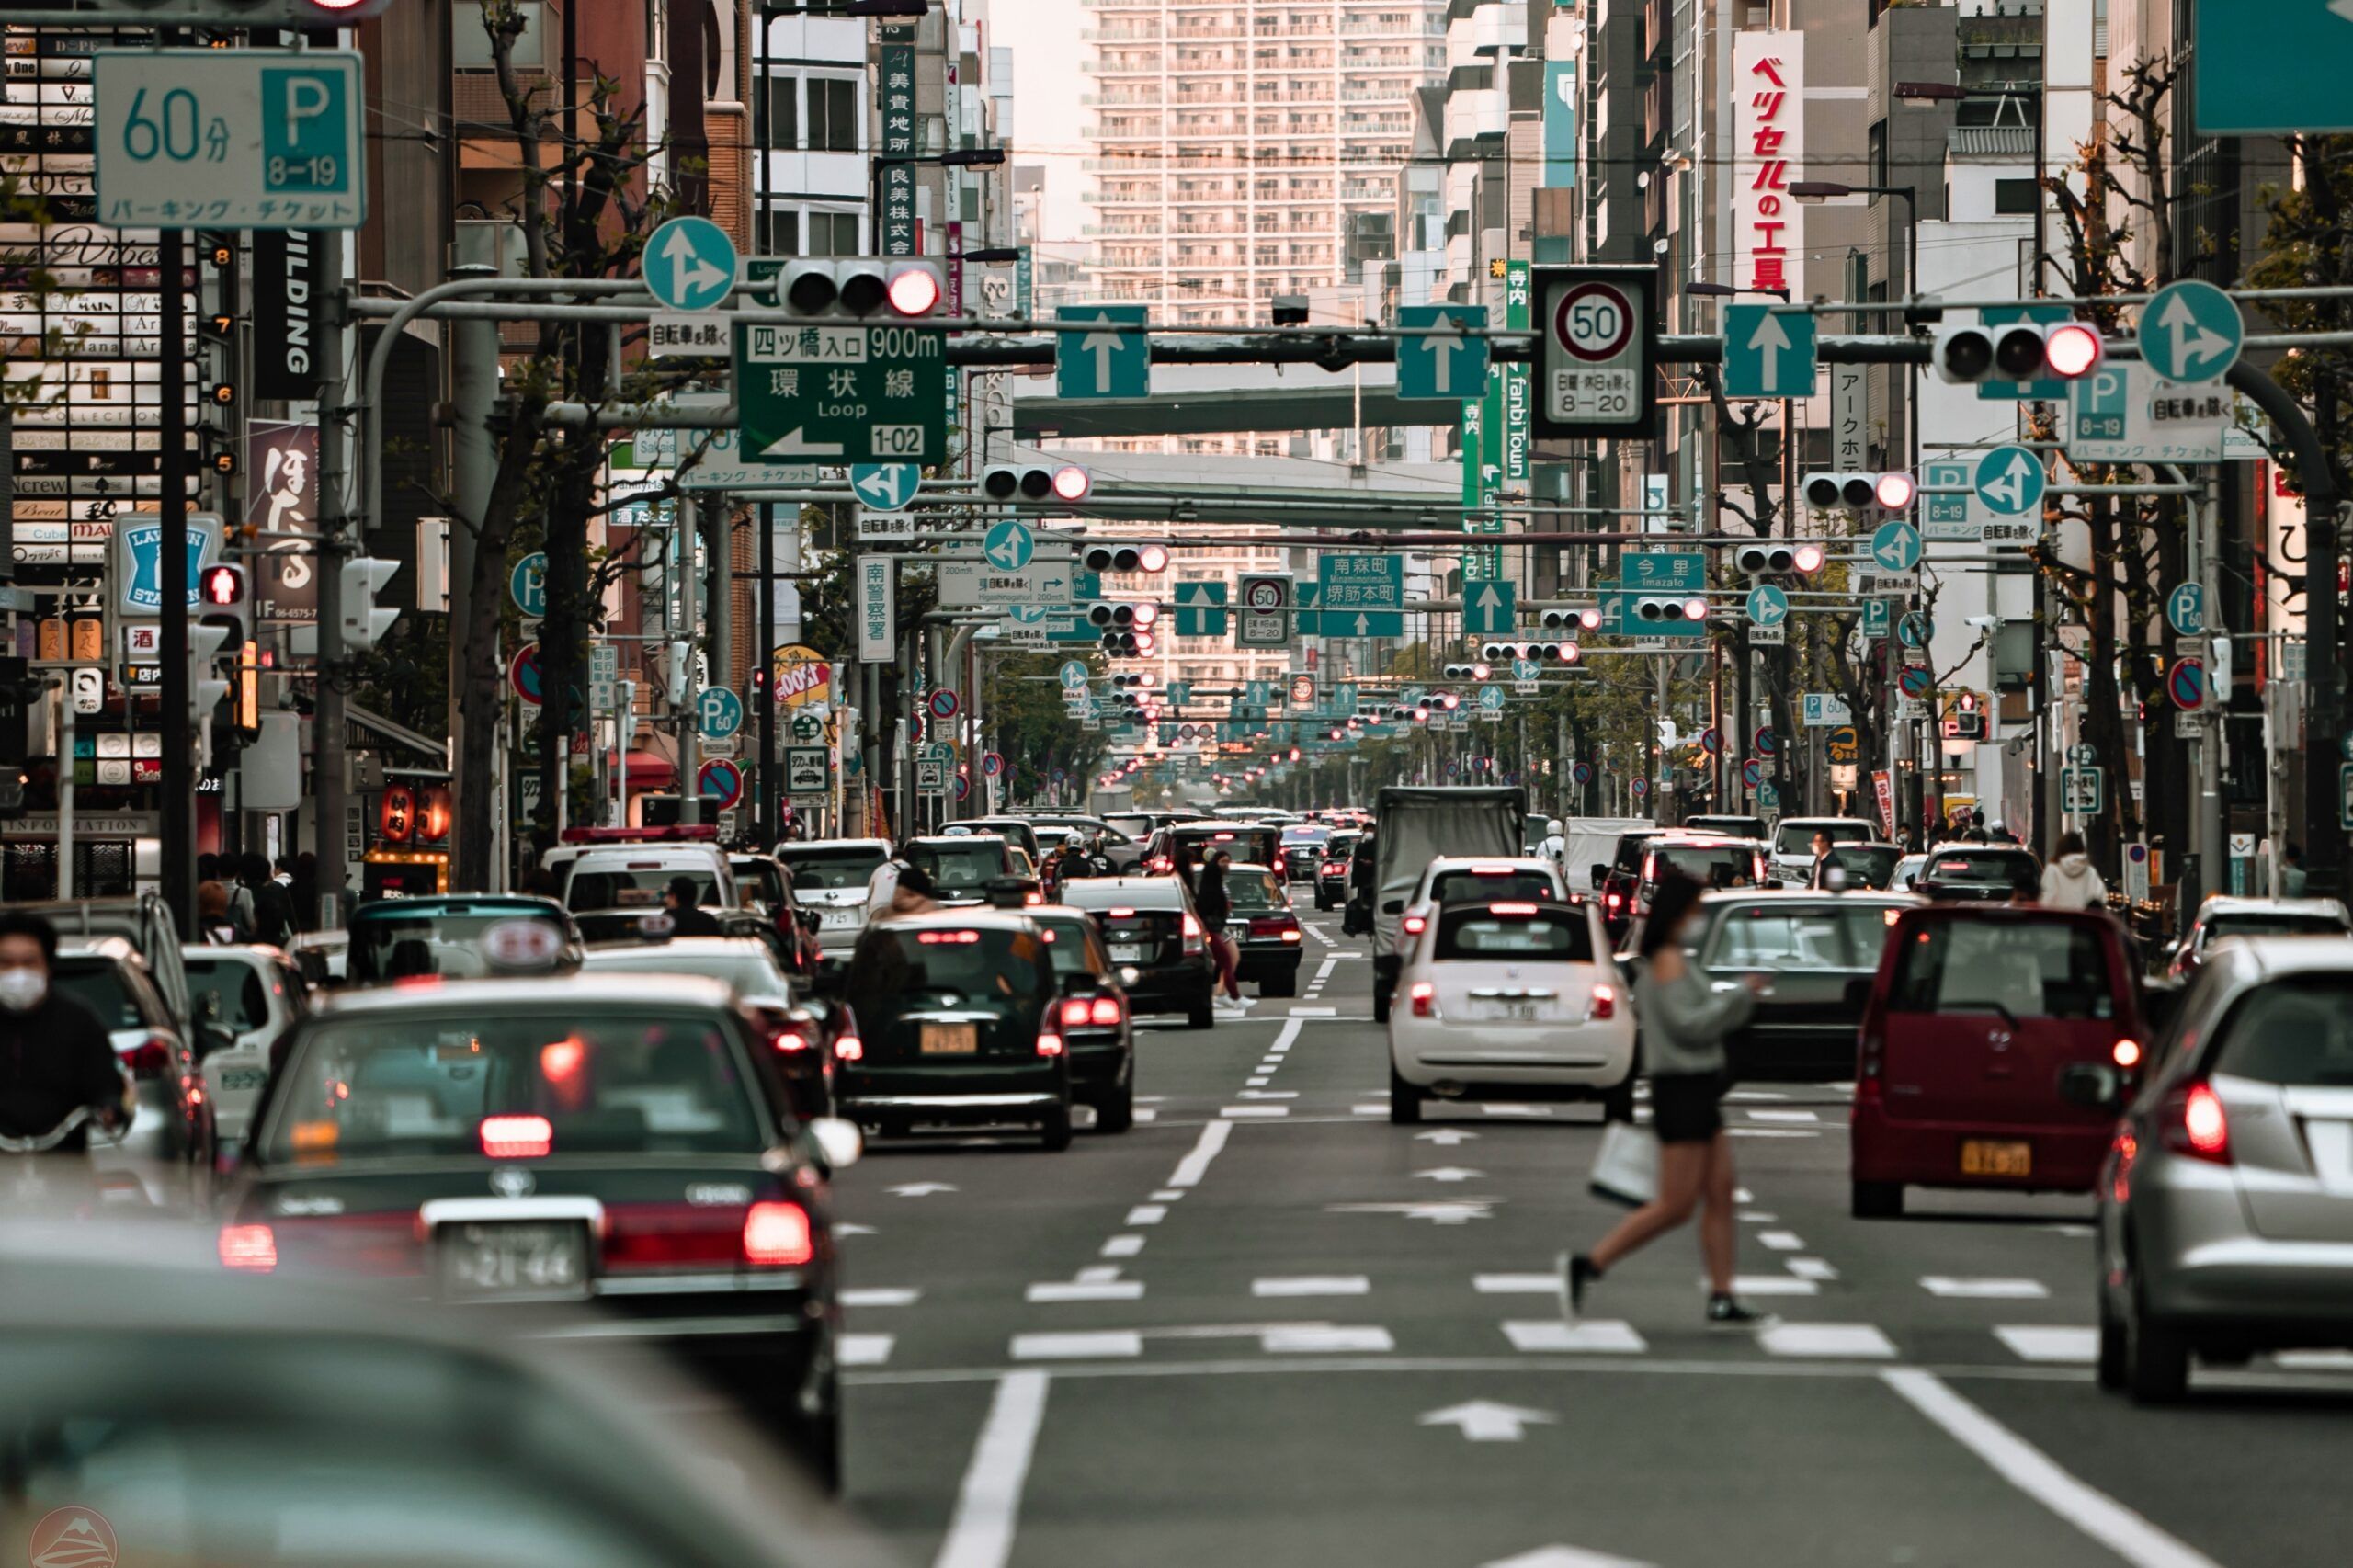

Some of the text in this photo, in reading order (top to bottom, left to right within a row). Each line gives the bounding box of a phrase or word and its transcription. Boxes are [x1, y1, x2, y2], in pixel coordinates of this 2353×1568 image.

[287, 77, 332, 148] P
[267, 155, 337, 187] 8-19
[215, 250, 230, 265] 8
[215, 318, 230, 333] 7
[1574, 305, 1616, 340] 50
[652, 324, 728, 347] 自転車を除く
[871, 327, 938, 358] 900m
[217, 387, 232, 403] 6
[2091, 372, 2119, 414] P
[817, 401, 868, 420] Loop
[1562, 394, 1627, 413] 8-20
[41, 412, 162, 422] COLLECTON
[2080, 417, 2121, 436] 8-19
[874, 428, 921, 454] 1-02
[1509, 426, 1527, 477] Town
[218, 456, 232, 472] 5
[1932, 506, 1963, 519] 8-19
[33, 528, 67, 540] Cube
[860, 517, 912, 534] 自転車を除く
[1984, 526, 2035, 540] 自転車を除く
[1334, 558, 1388, 574] 南森町
[1637, 559, 1689, 576] 今里
[1642, 578, 1684, 588] Imazato
[865, 562, 887, 641] 南警察署
[1256, 589, 1276, 605] 50
[1869, 601, 1884, 621] P
[2178, 595, 2196, 628] P
[133, 630, 153, 648] 酒
[1250, 629, 1279, 637] 8-20
[704, 699, 723, 732] P
[8, 820, 139, 832] INFOMATION
